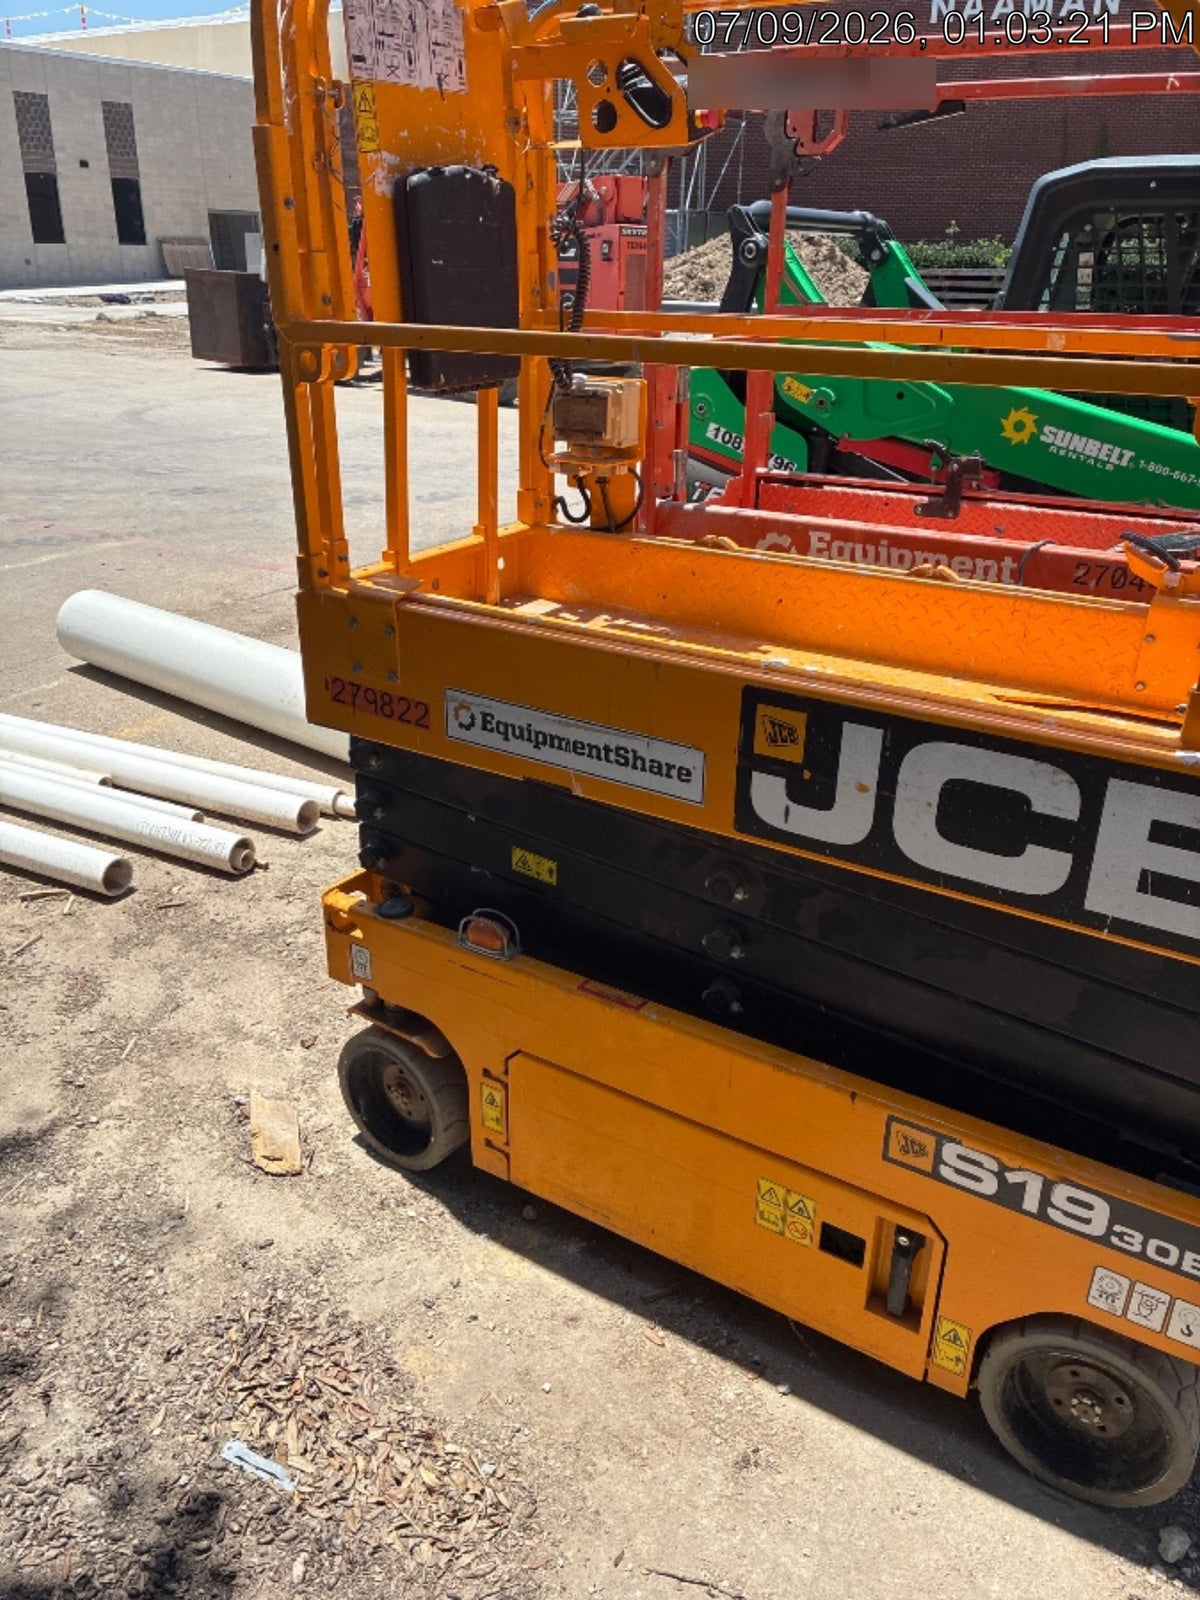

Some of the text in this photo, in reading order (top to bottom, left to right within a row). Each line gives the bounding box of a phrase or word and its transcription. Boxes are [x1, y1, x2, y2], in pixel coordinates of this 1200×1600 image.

[930, 0, 1122, 24] NAAMAN
[1040, 425, 1135, 467] SUNBELT
[1048, 445, 1114, 471] RENTALS
[331, 677, 430, 730] 279822
[479, 711, 693, 784] EquipmentShare
[765, 716, 799, 746] JCB
